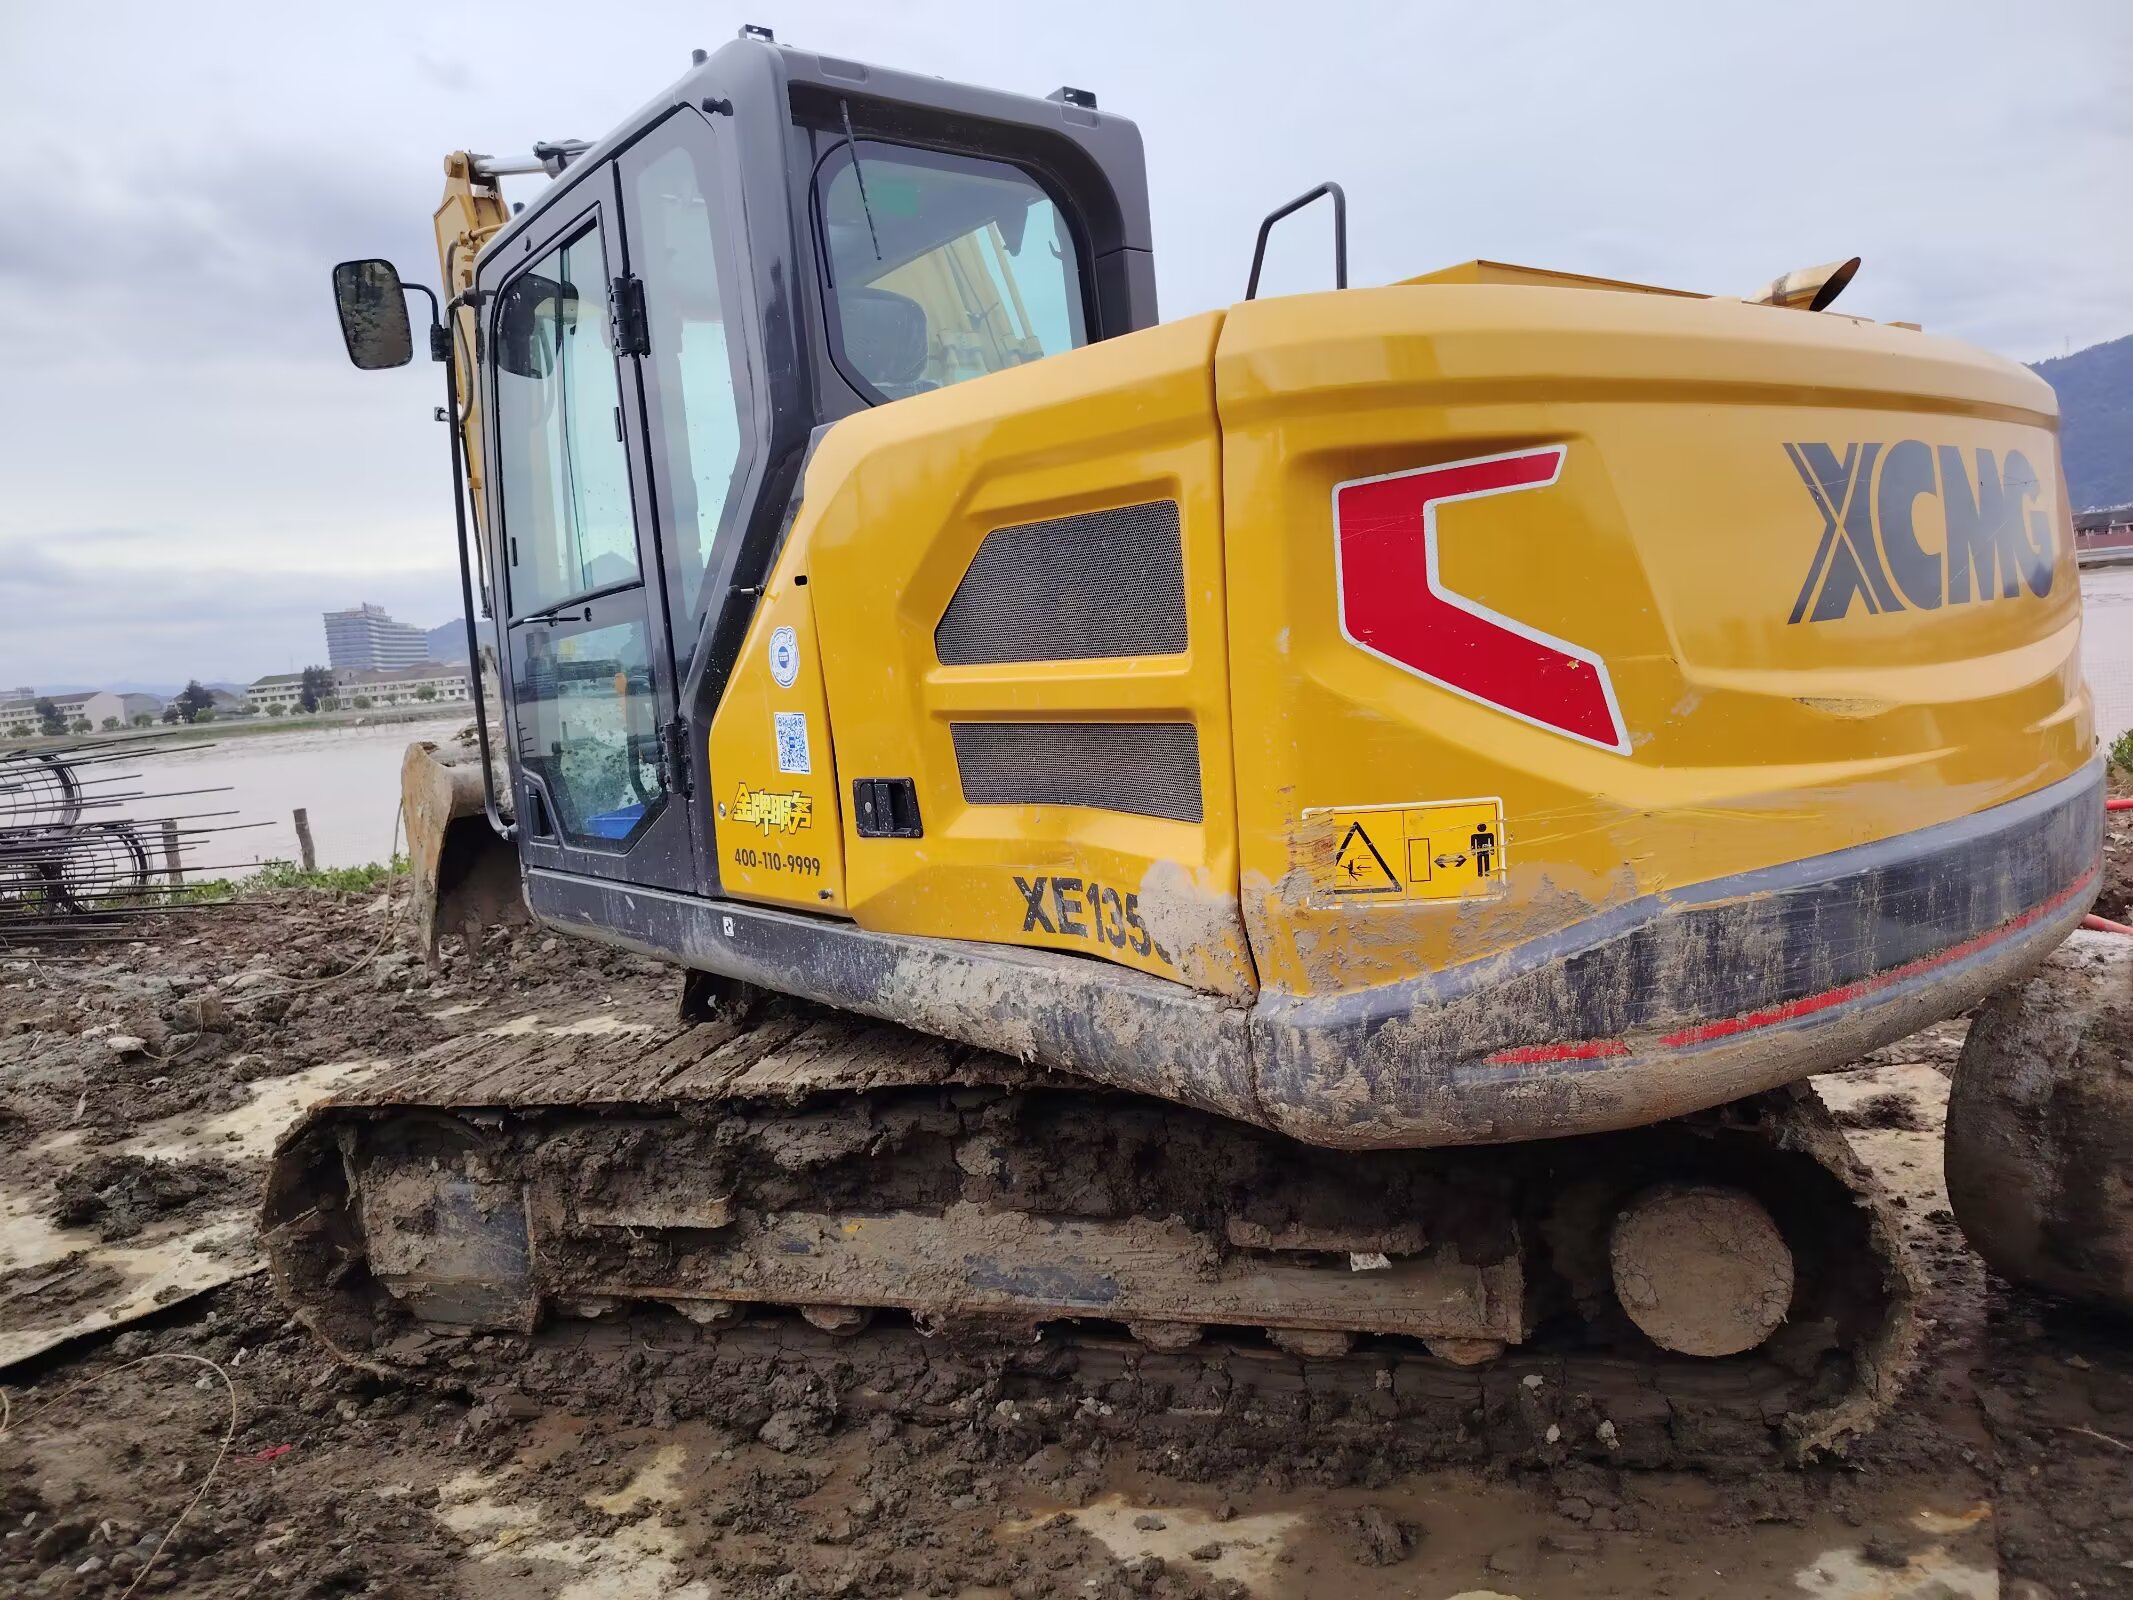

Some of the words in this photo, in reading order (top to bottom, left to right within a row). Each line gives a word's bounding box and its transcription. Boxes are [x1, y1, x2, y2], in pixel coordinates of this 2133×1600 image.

[1781, 439, 2055, 625] XCMG
[730, 782, 813, 837] 金牌服务
[735, 848, 820, 876] 400-110-9999
[1012, 876, 1174, 966] XE135
